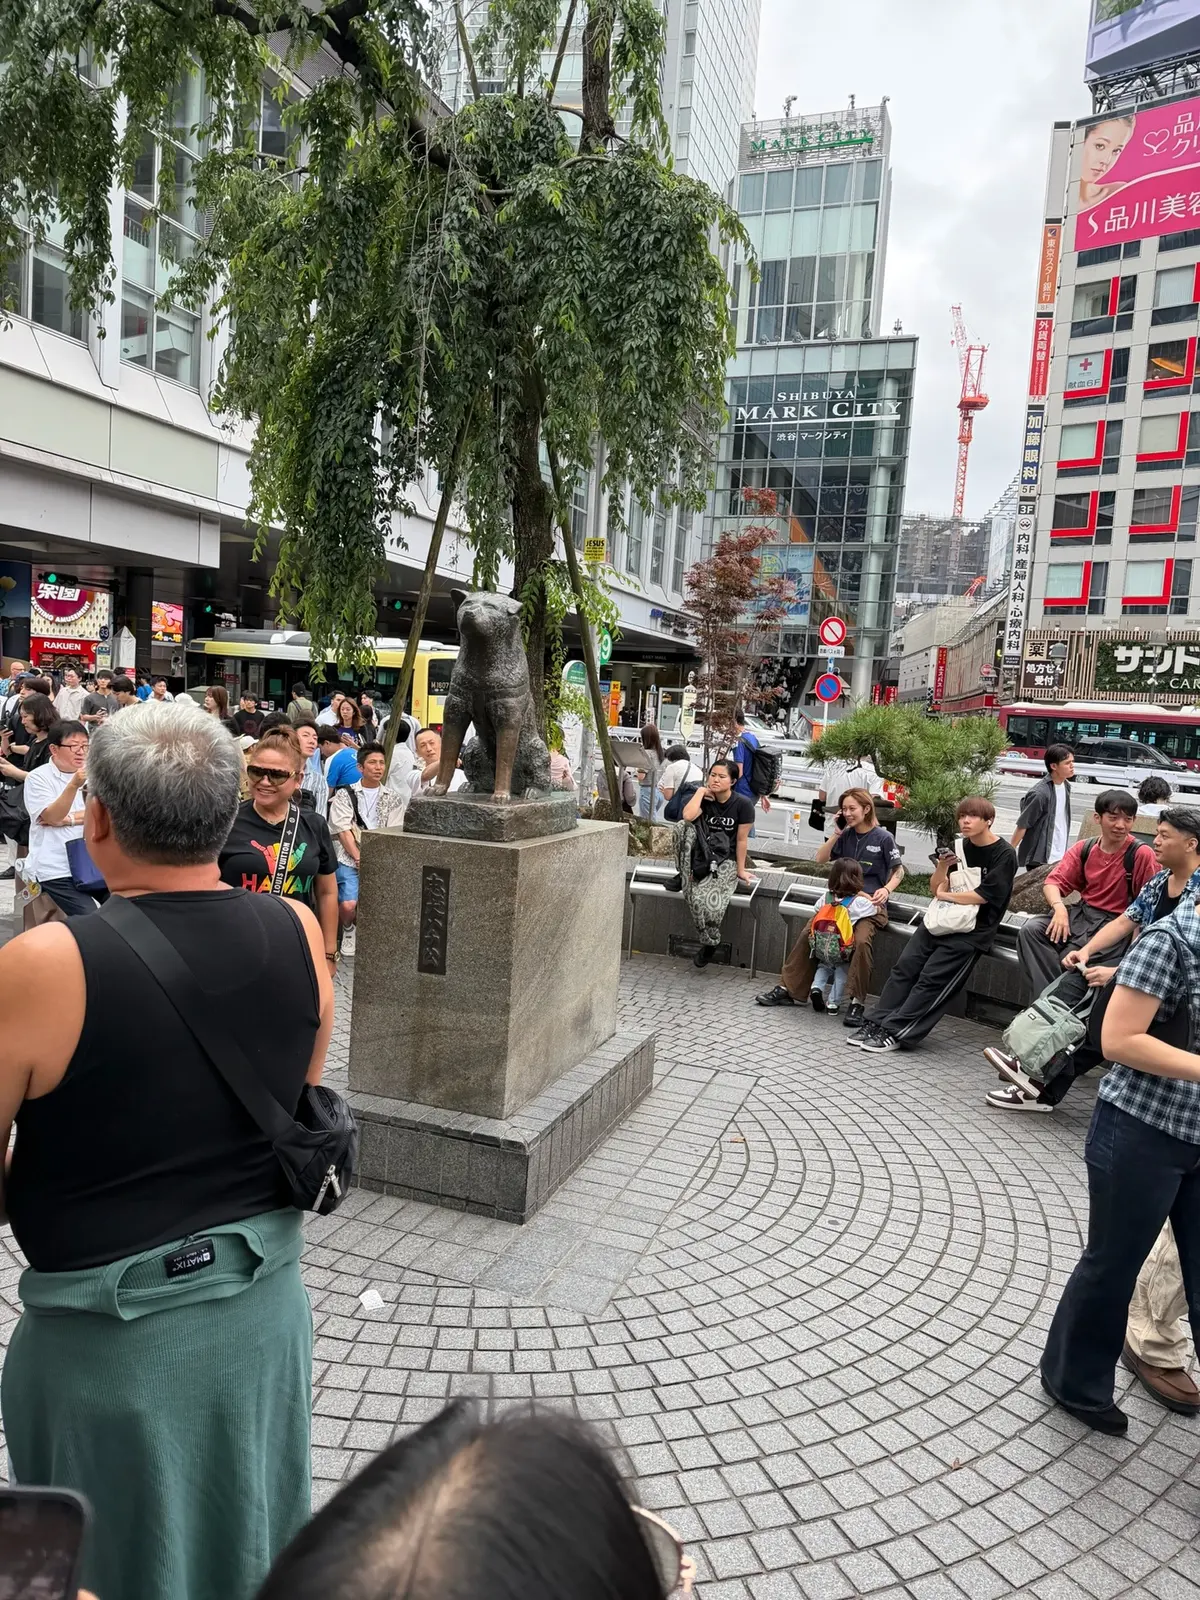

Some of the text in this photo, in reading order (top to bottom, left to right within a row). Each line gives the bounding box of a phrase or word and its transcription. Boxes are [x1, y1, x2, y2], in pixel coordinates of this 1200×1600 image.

[1173, 112, 1200, 137] 品
[749, 127, 872, 152] MARK CITY
[1042, 239, 1056, 302] 東京スター銀行
[1036, 320, 1049, 361] 外貨両替
[777, 390, 855, 402] SHIBUYA
[736, 401, 903, 421] MARK CITY
[1022, 414, 1042, 480] 加藤眼科
[1021, 485, 1035, 494] 5F
[1020, 505, 1034, 514] 3F
[586, 539, 604, 547] JESUS
[55, 600, 91, 623] AMUSEMENT
[100, 628, 109, 636] 33
[43, 641, 82, 651] RAKUEN
[1028, 642, 1045, 657] 薬
[1113, 645, 1200, 675] サンド
[1025, 662, 1065, 675] 処方せん
[1034, 675, 1054, 686] 受付
[272, 842, 291, 894] LOUIS VUITTON
[175, 1254, 204, 1269] MATIX
